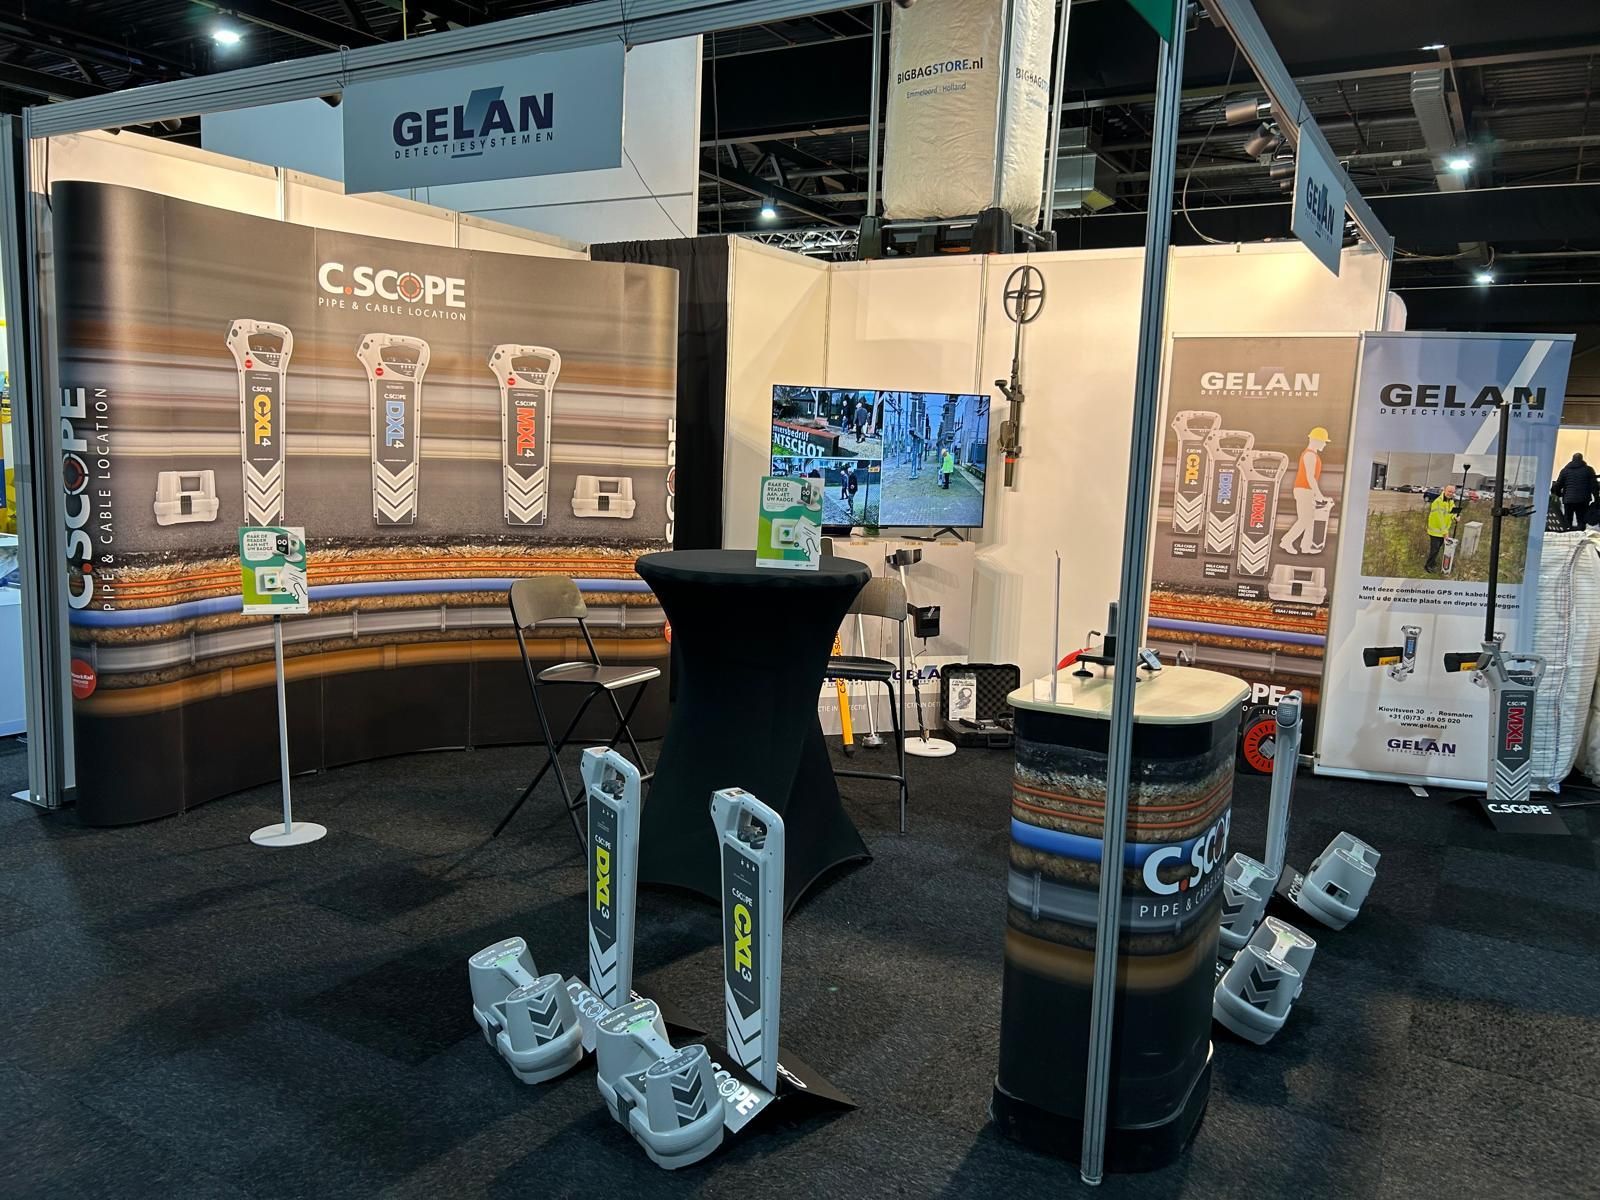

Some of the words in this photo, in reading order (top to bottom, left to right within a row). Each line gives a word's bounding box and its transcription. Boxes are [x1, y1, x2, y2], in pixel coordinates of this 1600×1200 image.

[897, 57, 984, 85] BIGBAGSTORE.nl
[942, 82, 967, 92] Holland
[393, 92, 554, 147] GELAN
[394, 131, 554, 160] DETECTIESYSTEMEN
[1306, 176, 1335, 236] GELAN
[318, 262, 466, 308] C.SCOPE
[318, 297, 345, 309] PIPE
[352, 301, 359, 310] &
[365, 302, 403, 316] CABLE
[408, 307, 467, 321] LOCATION
[1200, 371, 1321, 391] GELAN
[1379, 383, 1547, 411] GELAN
[1380, 407, 1545, 419] DETECTIESYSTMEN
[94, 387, 111, 479] LOCATION
[60, 387, 94, 610] C.SCOPE
[98, 489, 113, 544] CABLE
[101, 554, 114, 564] &
[102, 573, 116, 611] PIPE
[1454, 600, 1477, 608] diepte
[892, 669, 941, 680] GELA
[1438, 710, 1473, 719] Rosmalen
[1387, 738, 1456, 754] GELAN
[1487, 803, 1552, 815] C.SCOPE
[1143, 808, 1231, 895] C.SCOP
[1140, 903, 1180, 918] PIPE
[1185, 898, 1192, 911] &
